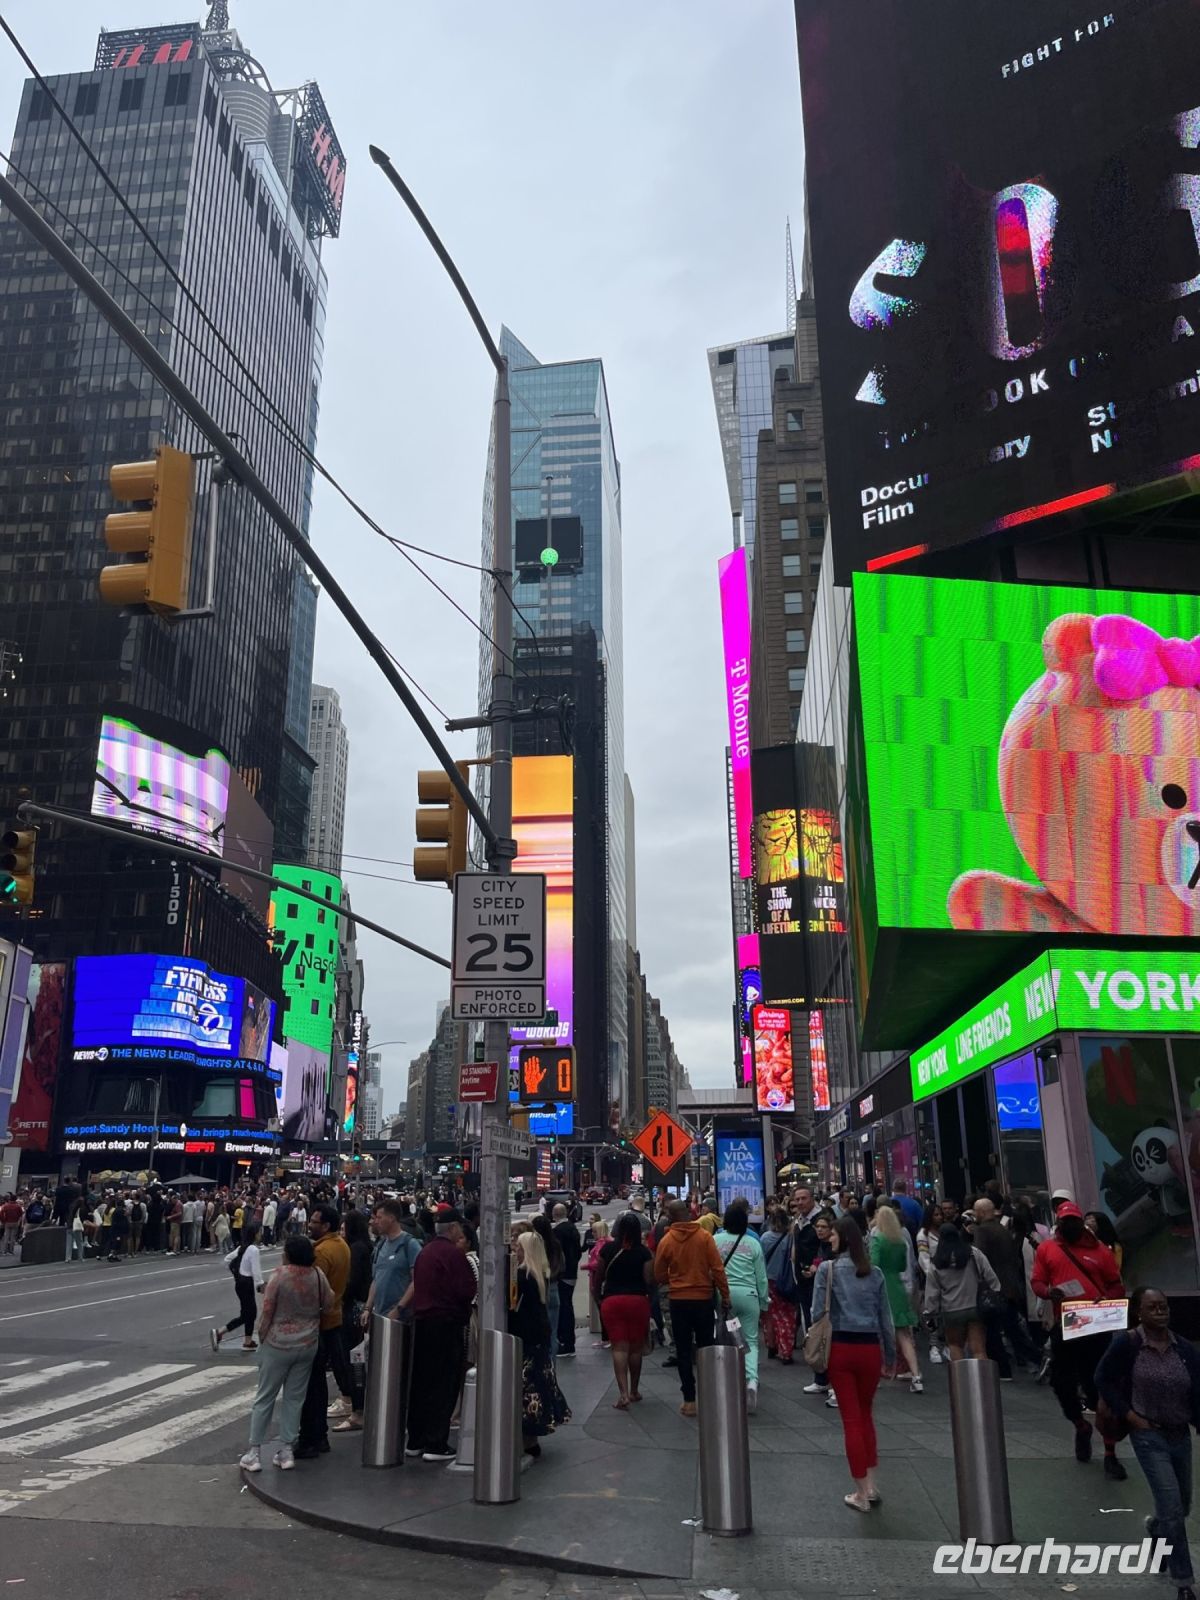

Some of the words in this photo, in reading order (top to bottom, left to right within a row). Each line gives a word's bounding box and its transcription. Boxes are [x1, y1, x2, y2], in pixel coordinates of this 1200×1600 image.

[1001, 37, 1063, 79] FIGHT
[862, 501, 914, 530] Film
[481, 880, 517, 893] CITY
[769, 886, 788, 899] THE
[472, 897, 525, 910] SPEED
[767, 897, 793, 911] SHOW
[478, 914, 519, 926] LIMIT
[771, 910, 782, 922] OF
[783, 909, 791, 921] A
[762, 920, 801, 935] LIFETIME
[465, 932, 534, 973] 25
[475, 989, 522, 1001] PHOTO
[1024, 968, 1062, 1023] NEW
[460, 1003, 537, 1014] ENFORCED
[918, 1055, 931, 1087] NEW
[930, 1044, 949, 1078] YORK
[955, 1026, 974, 1065] LINE
[972, 1002, 1012, 1055] FRIENDS
[111, 1049, 132, 1058] THE
[134, 1049, 166, 1059] NEWS
[233, 1060, 246, 1069] AT
[461, 1068, 469, 1076] NO
[469, 1066, 492, 1075] STANDING
[461, 1077, 480, 1086] Anytime
[65, 1140, 86, 1152] king
[87, 1141, 106, 1149] next
[108, 1140, 131, 1151] step
[134, 1140, 149, 1149] for
[730, 1142, 747, 1151] LA
[724, 1152, 755, 1161] VIDA
